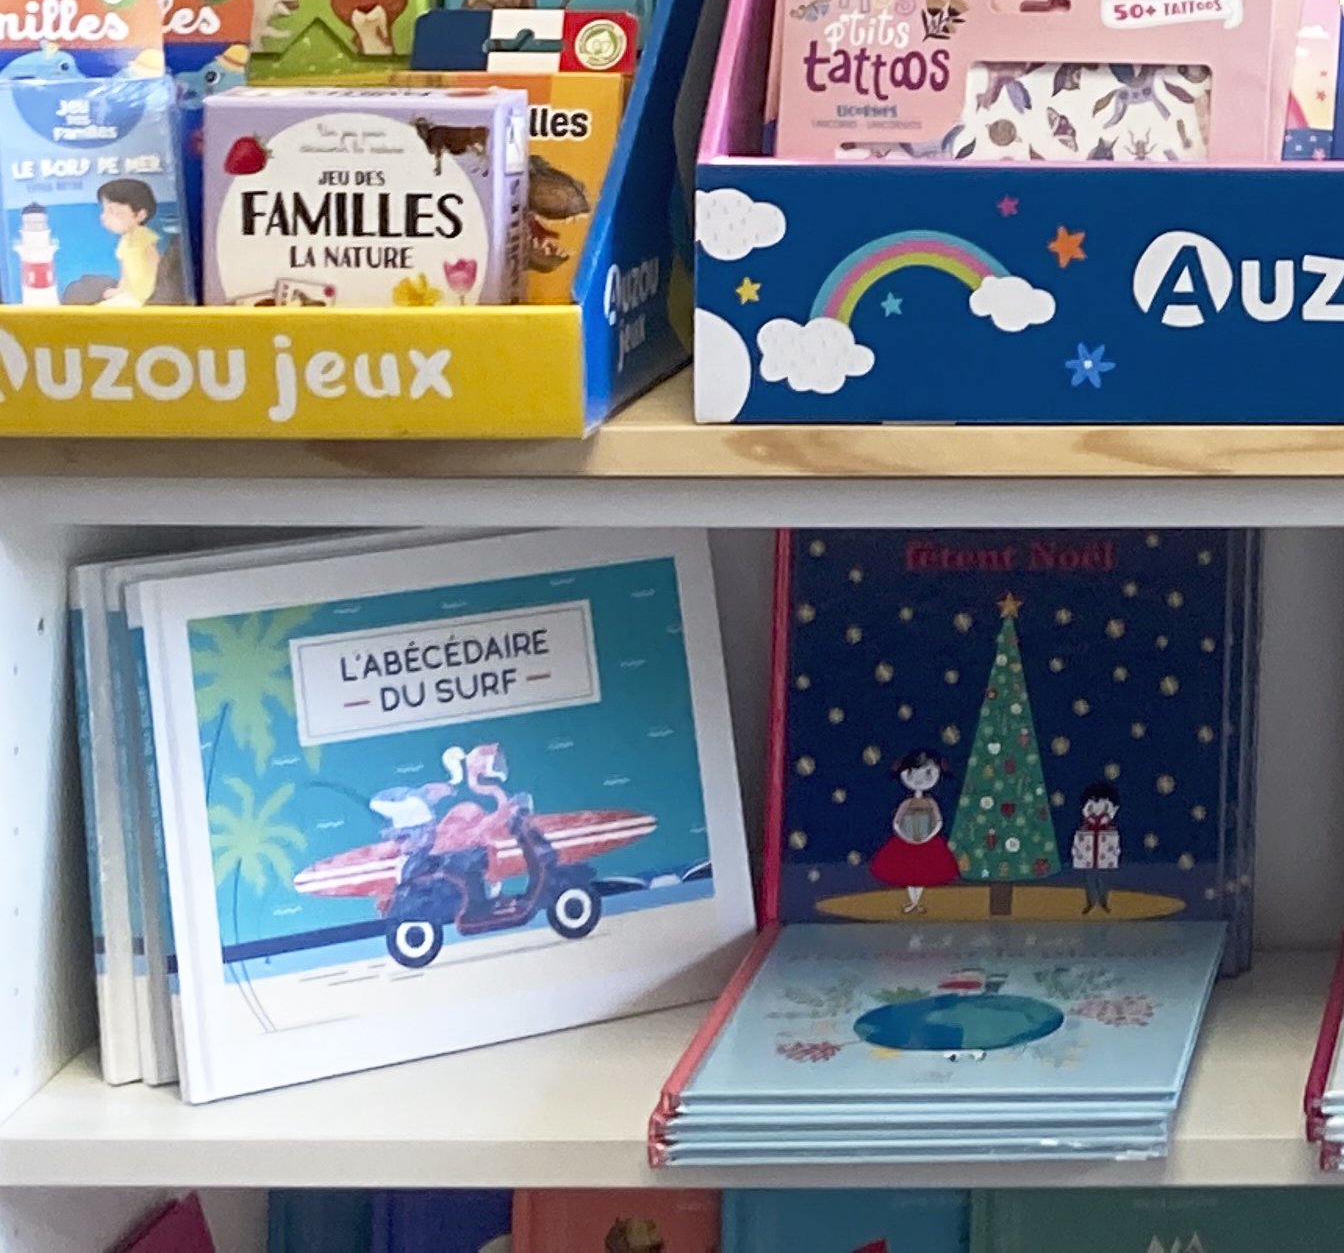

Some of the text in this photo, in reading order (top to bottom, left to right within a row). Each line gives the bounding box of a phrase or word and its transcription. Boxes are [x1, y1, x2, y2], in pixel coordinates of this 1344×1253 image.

[803, 40, 951, 101] tattoos
[317, 170, 387, 187] JEU DES
[240, 189, 465, 240] FAMILLES
[289, 245, 415, 271] LA NATURE
[270, 334, 455, 423] jeux
[338, 628, 550, 683] L'ABÉCÉDAIRE
[379, 667, 519, 715] DU SURF
